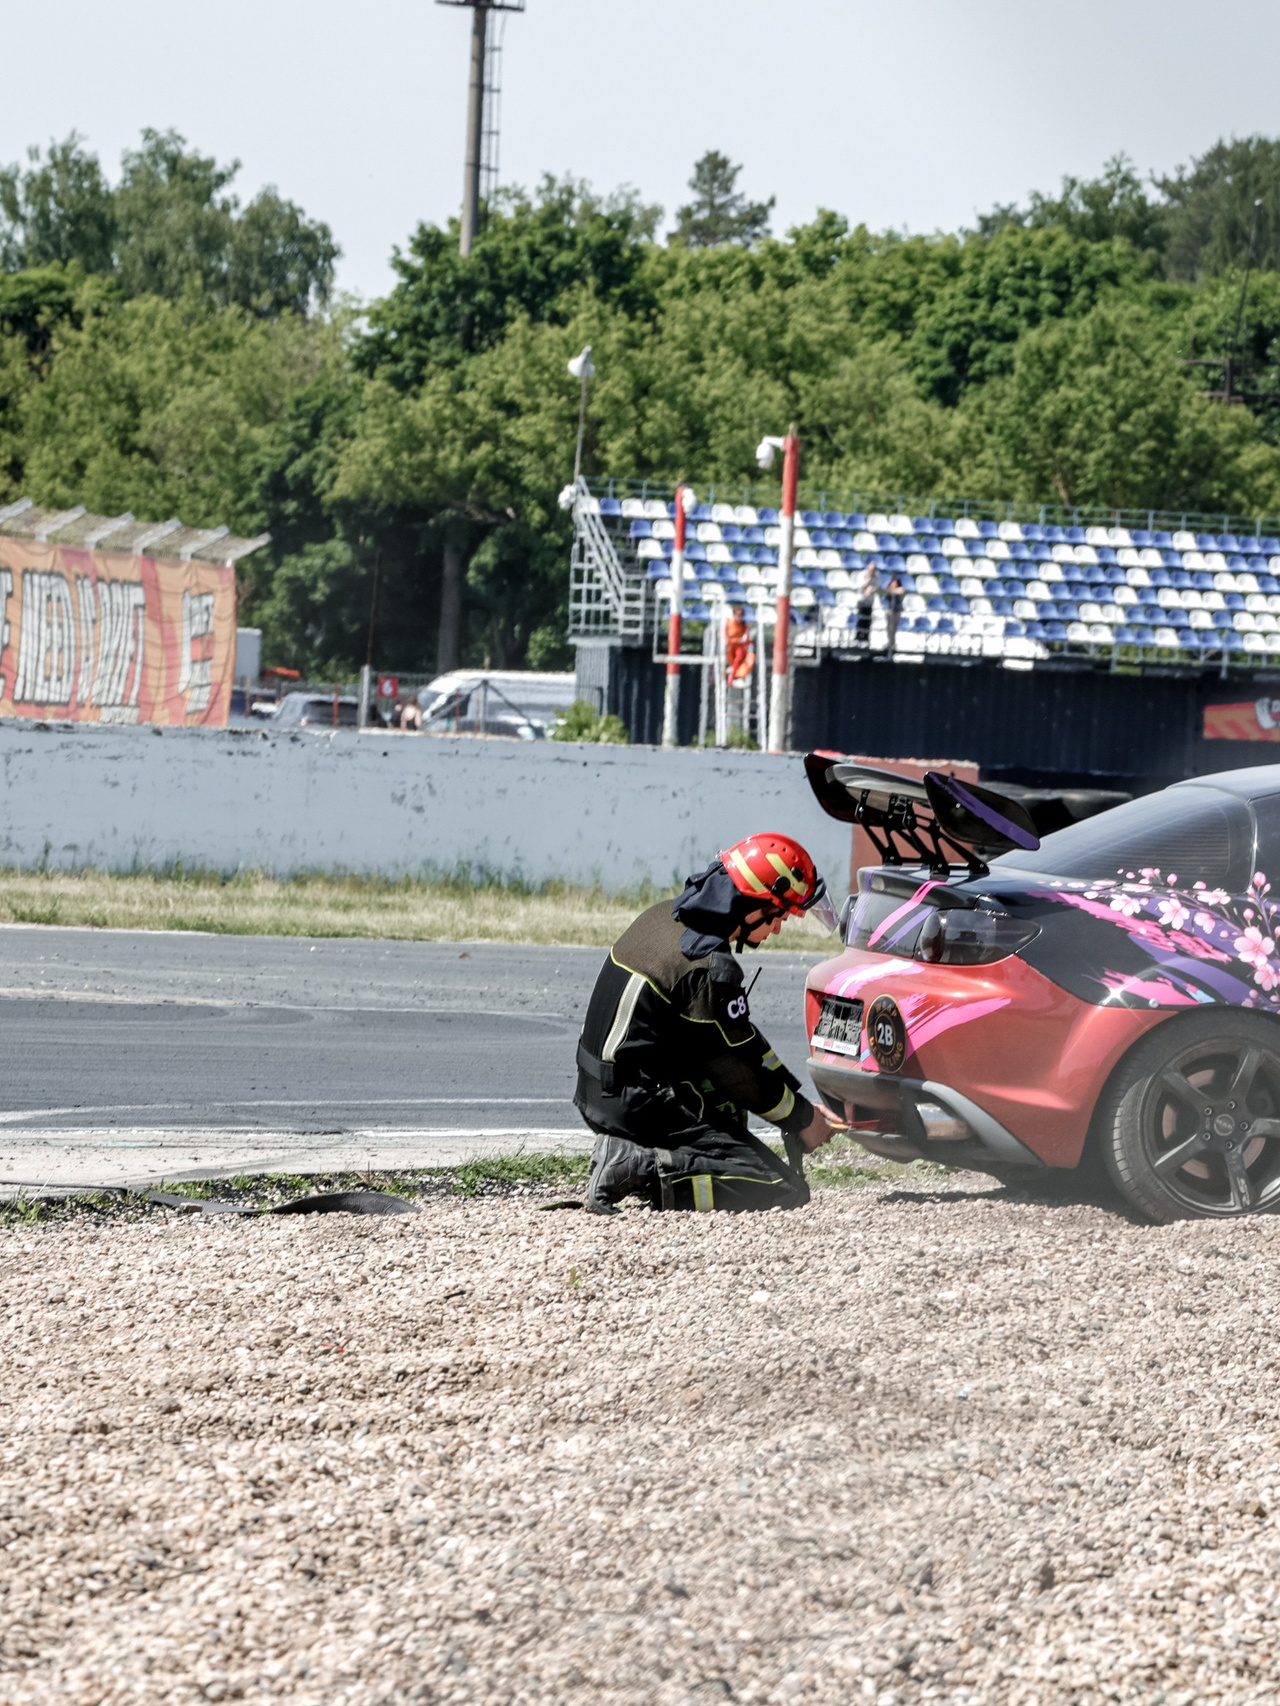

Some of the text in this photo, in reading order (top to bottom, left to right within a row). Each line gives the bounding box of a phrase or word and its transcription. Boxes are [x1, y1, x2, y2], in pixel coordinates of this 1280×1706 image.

[13, 568, 76, 705] NEED
[91, 577, 146, 706] DRIFT
[875, 1001, 897, 1017] WRAP
[877, 1023, 894, 1046] 2B
[869, 1036, 904, 1067] DETAILING
